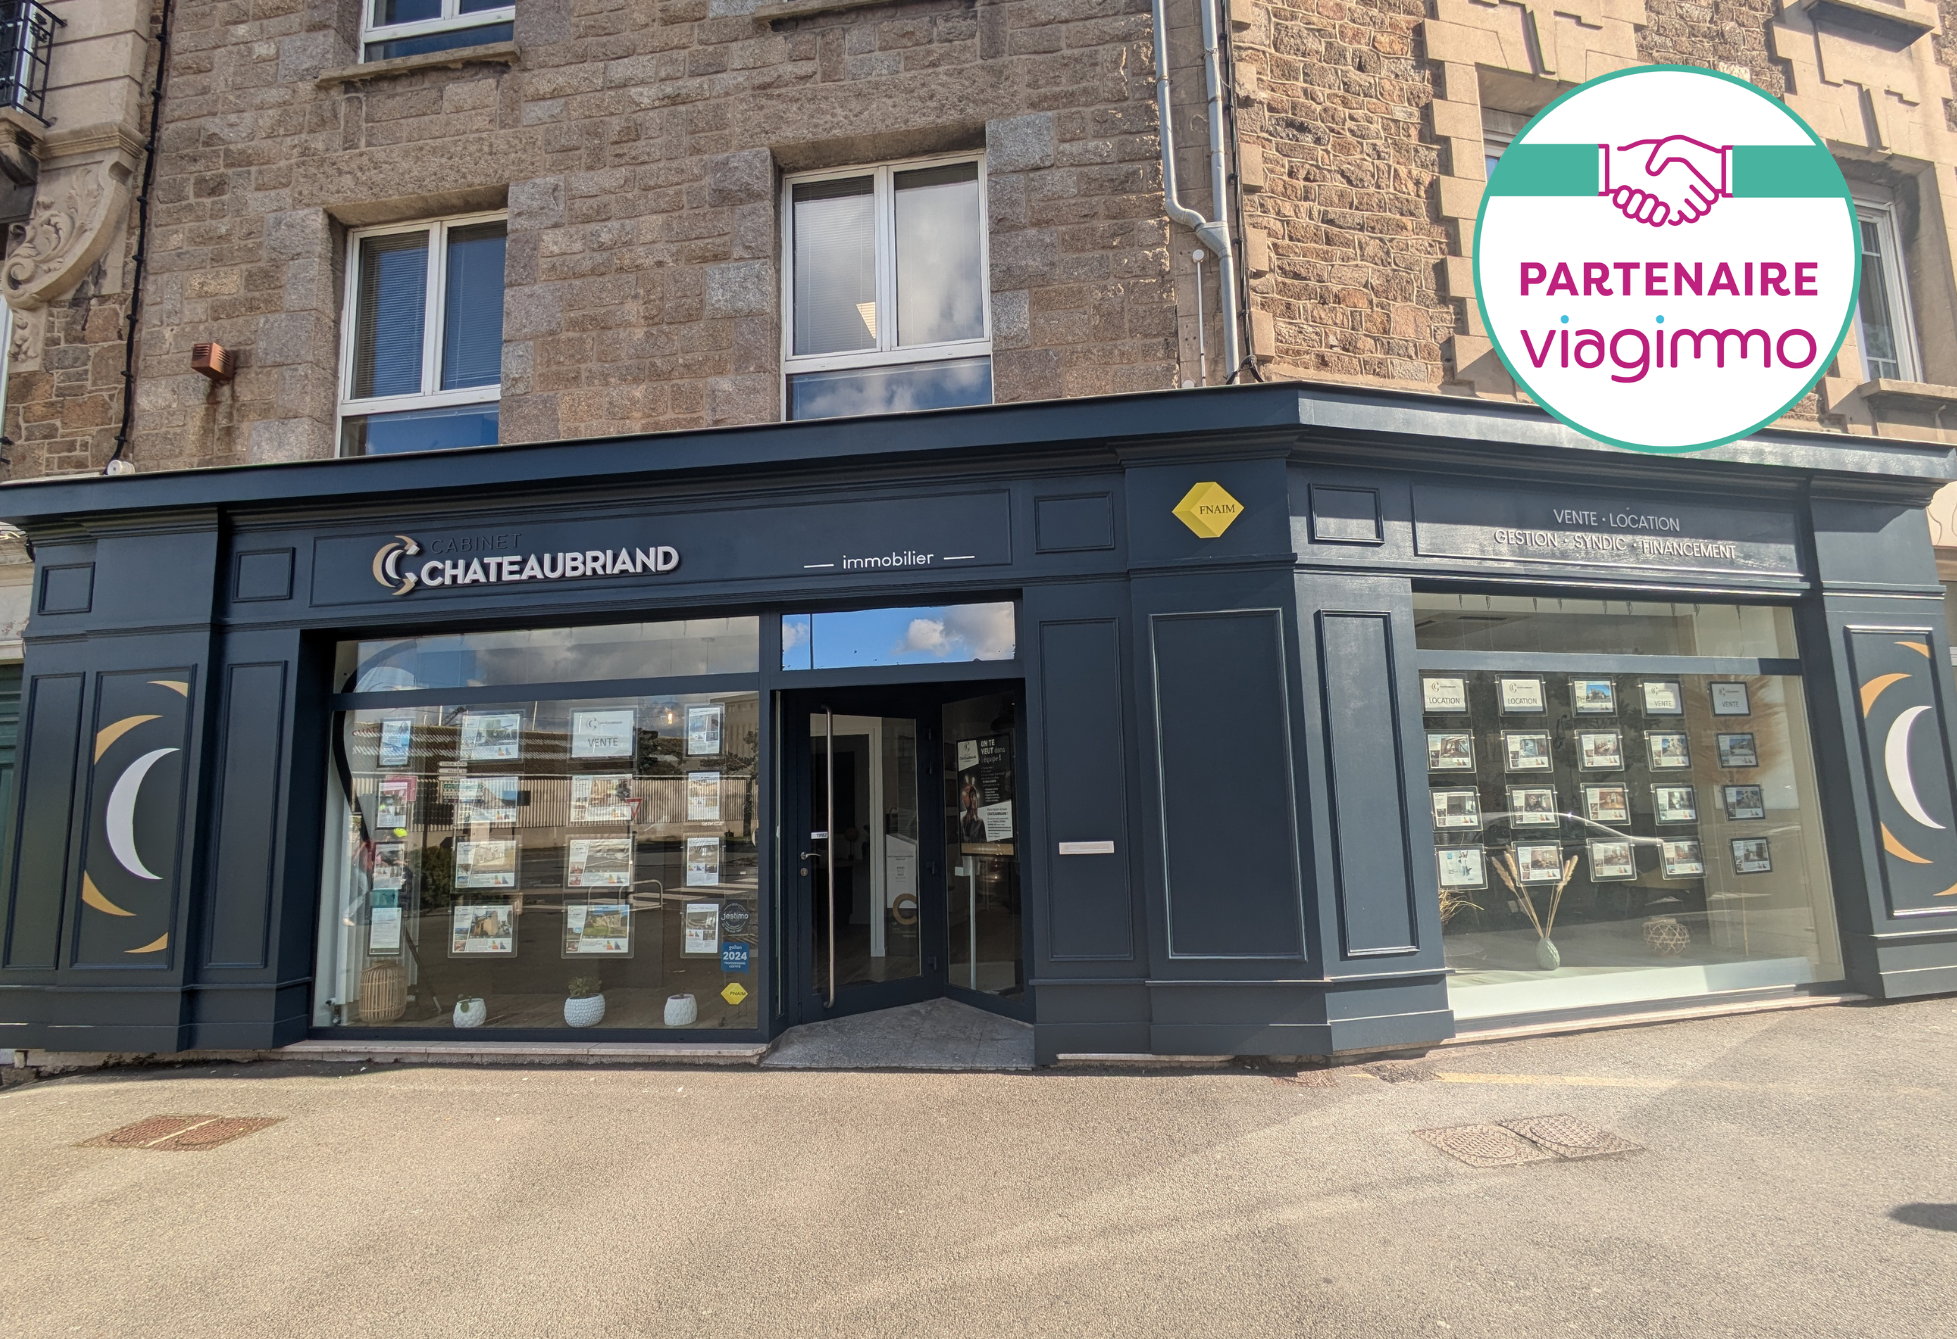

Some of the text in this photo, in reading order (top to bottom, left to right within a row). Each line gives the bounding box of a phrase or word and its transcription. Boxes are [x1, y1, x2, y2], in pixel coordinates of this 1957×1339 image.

[1199, 504, 1236, 515] FNAIM
[1553, 508, 1681, 532] VENTE LOCATION
[430, 533, 522, 555] CABINET
[1493, 529, 1737, 560] GESTION SYNDIC FINANCEMENT
[420, 545, 680, 588] CHATEAUBRIAND
[842, 553, 935, 570] immobilier
[1428, 697, 1461, 705] LOCATION
[1507, 697, 1538, 705] LOCATION
[1721, 700, 1740, 708] VENTE
[587, 737, 619, 748] VENTE
[722, 951, 748, 961] 2024
